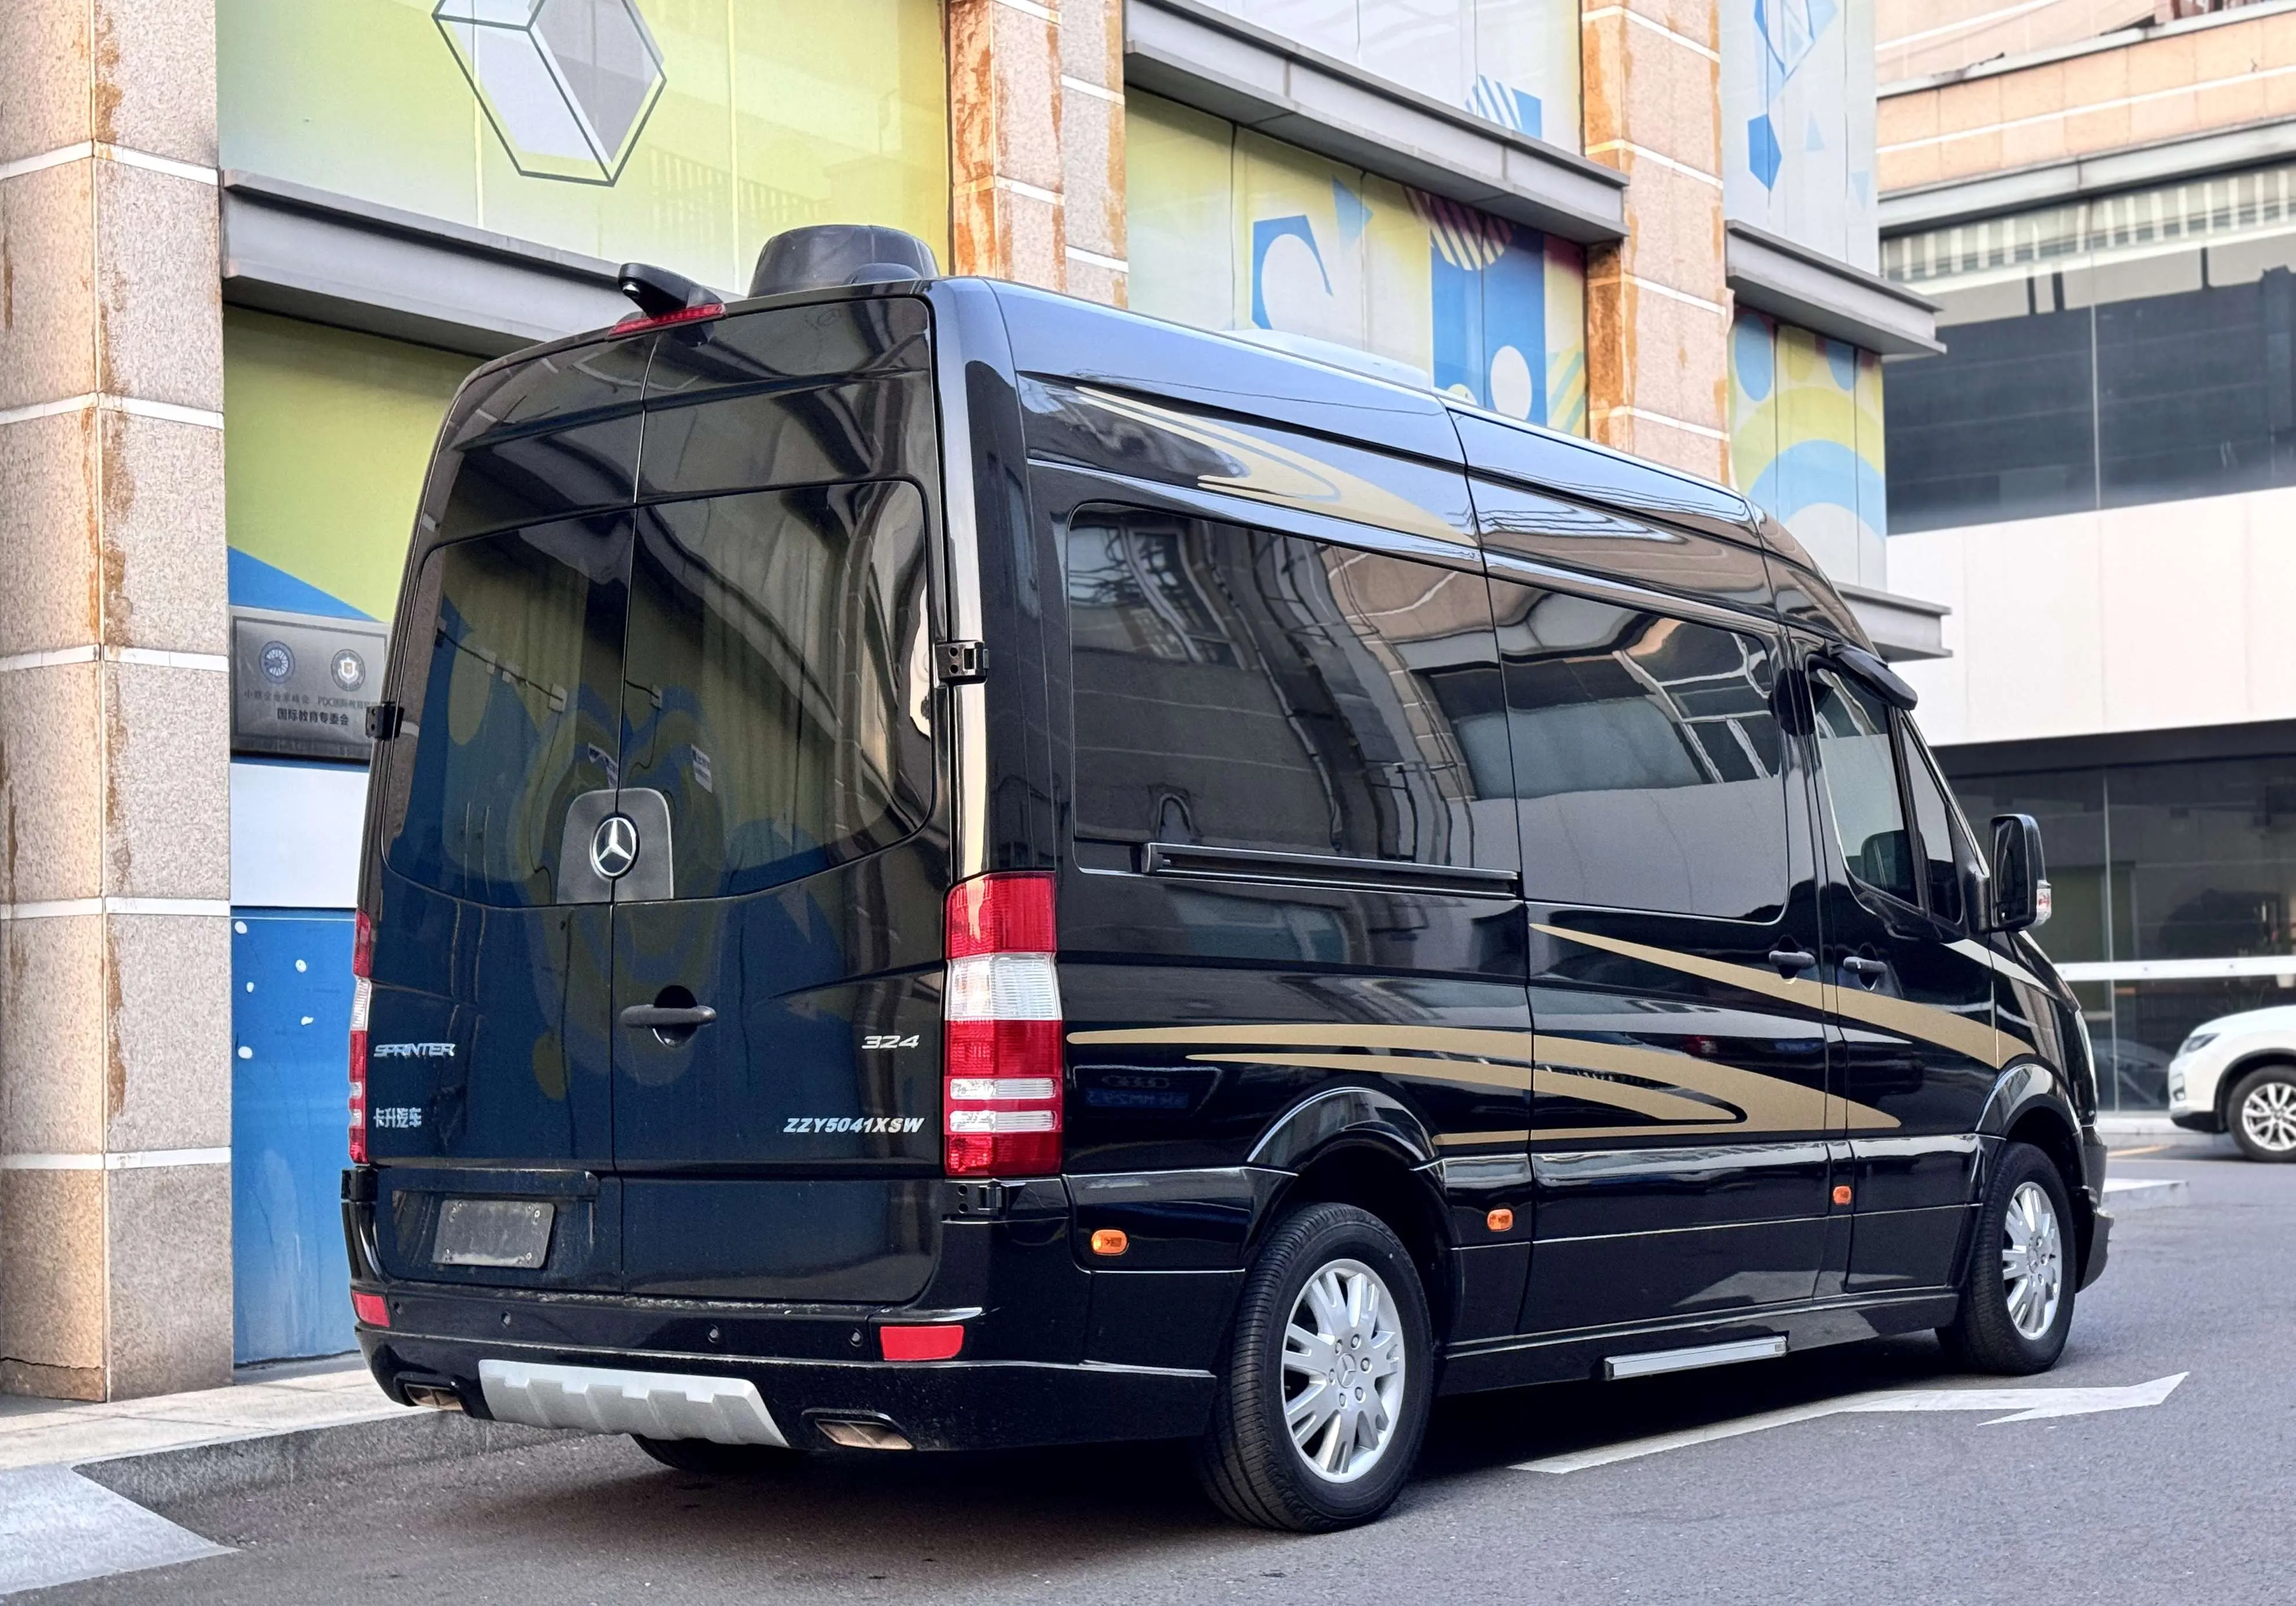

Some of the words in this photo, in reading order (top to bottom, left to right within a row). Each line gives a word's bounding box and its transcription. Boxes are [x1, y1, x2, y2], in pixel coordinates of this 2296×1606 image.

[278, 708, 349, 726] 国际教育专委会
[373, 1043, 456, 1058] SPRINTER
[861, 1034, 920, 1050] 324
[373, 1107, 422, 1129] 卡升汽车
[783, 1117, 925, 1134] ZZY5041XSW
